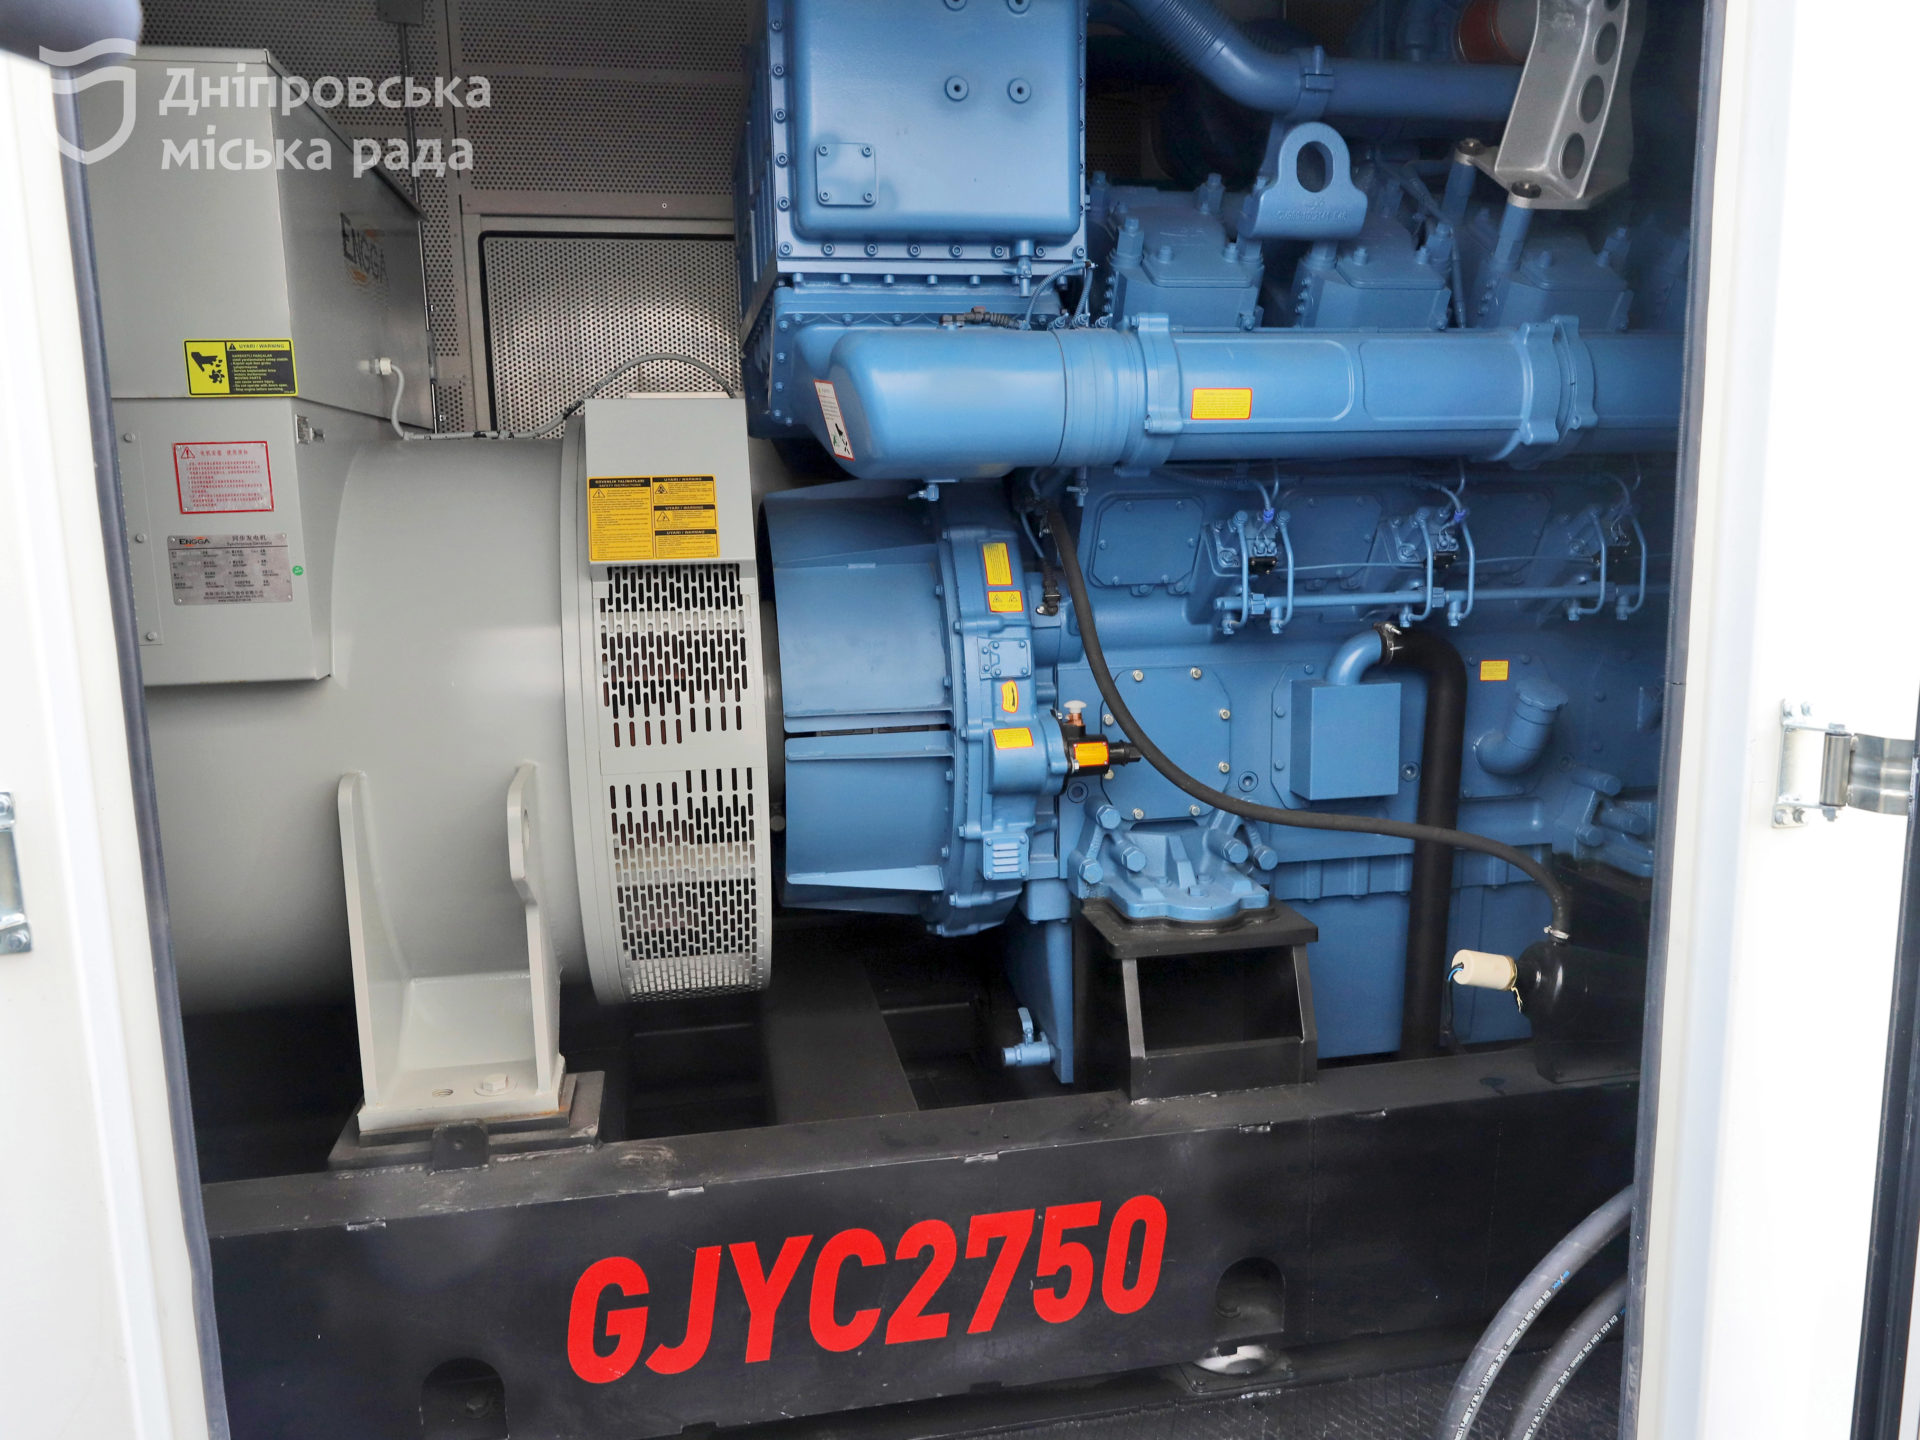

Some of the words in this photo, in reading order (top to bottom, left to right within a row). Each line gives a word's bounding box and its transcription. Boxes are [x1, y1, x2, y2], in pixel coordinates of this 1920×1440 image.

[340, 212, 389, 288] ENGGA
[179, 538, 210, 546] ENGGA
[567, 1195, 1167, 1384] GJYC2750
